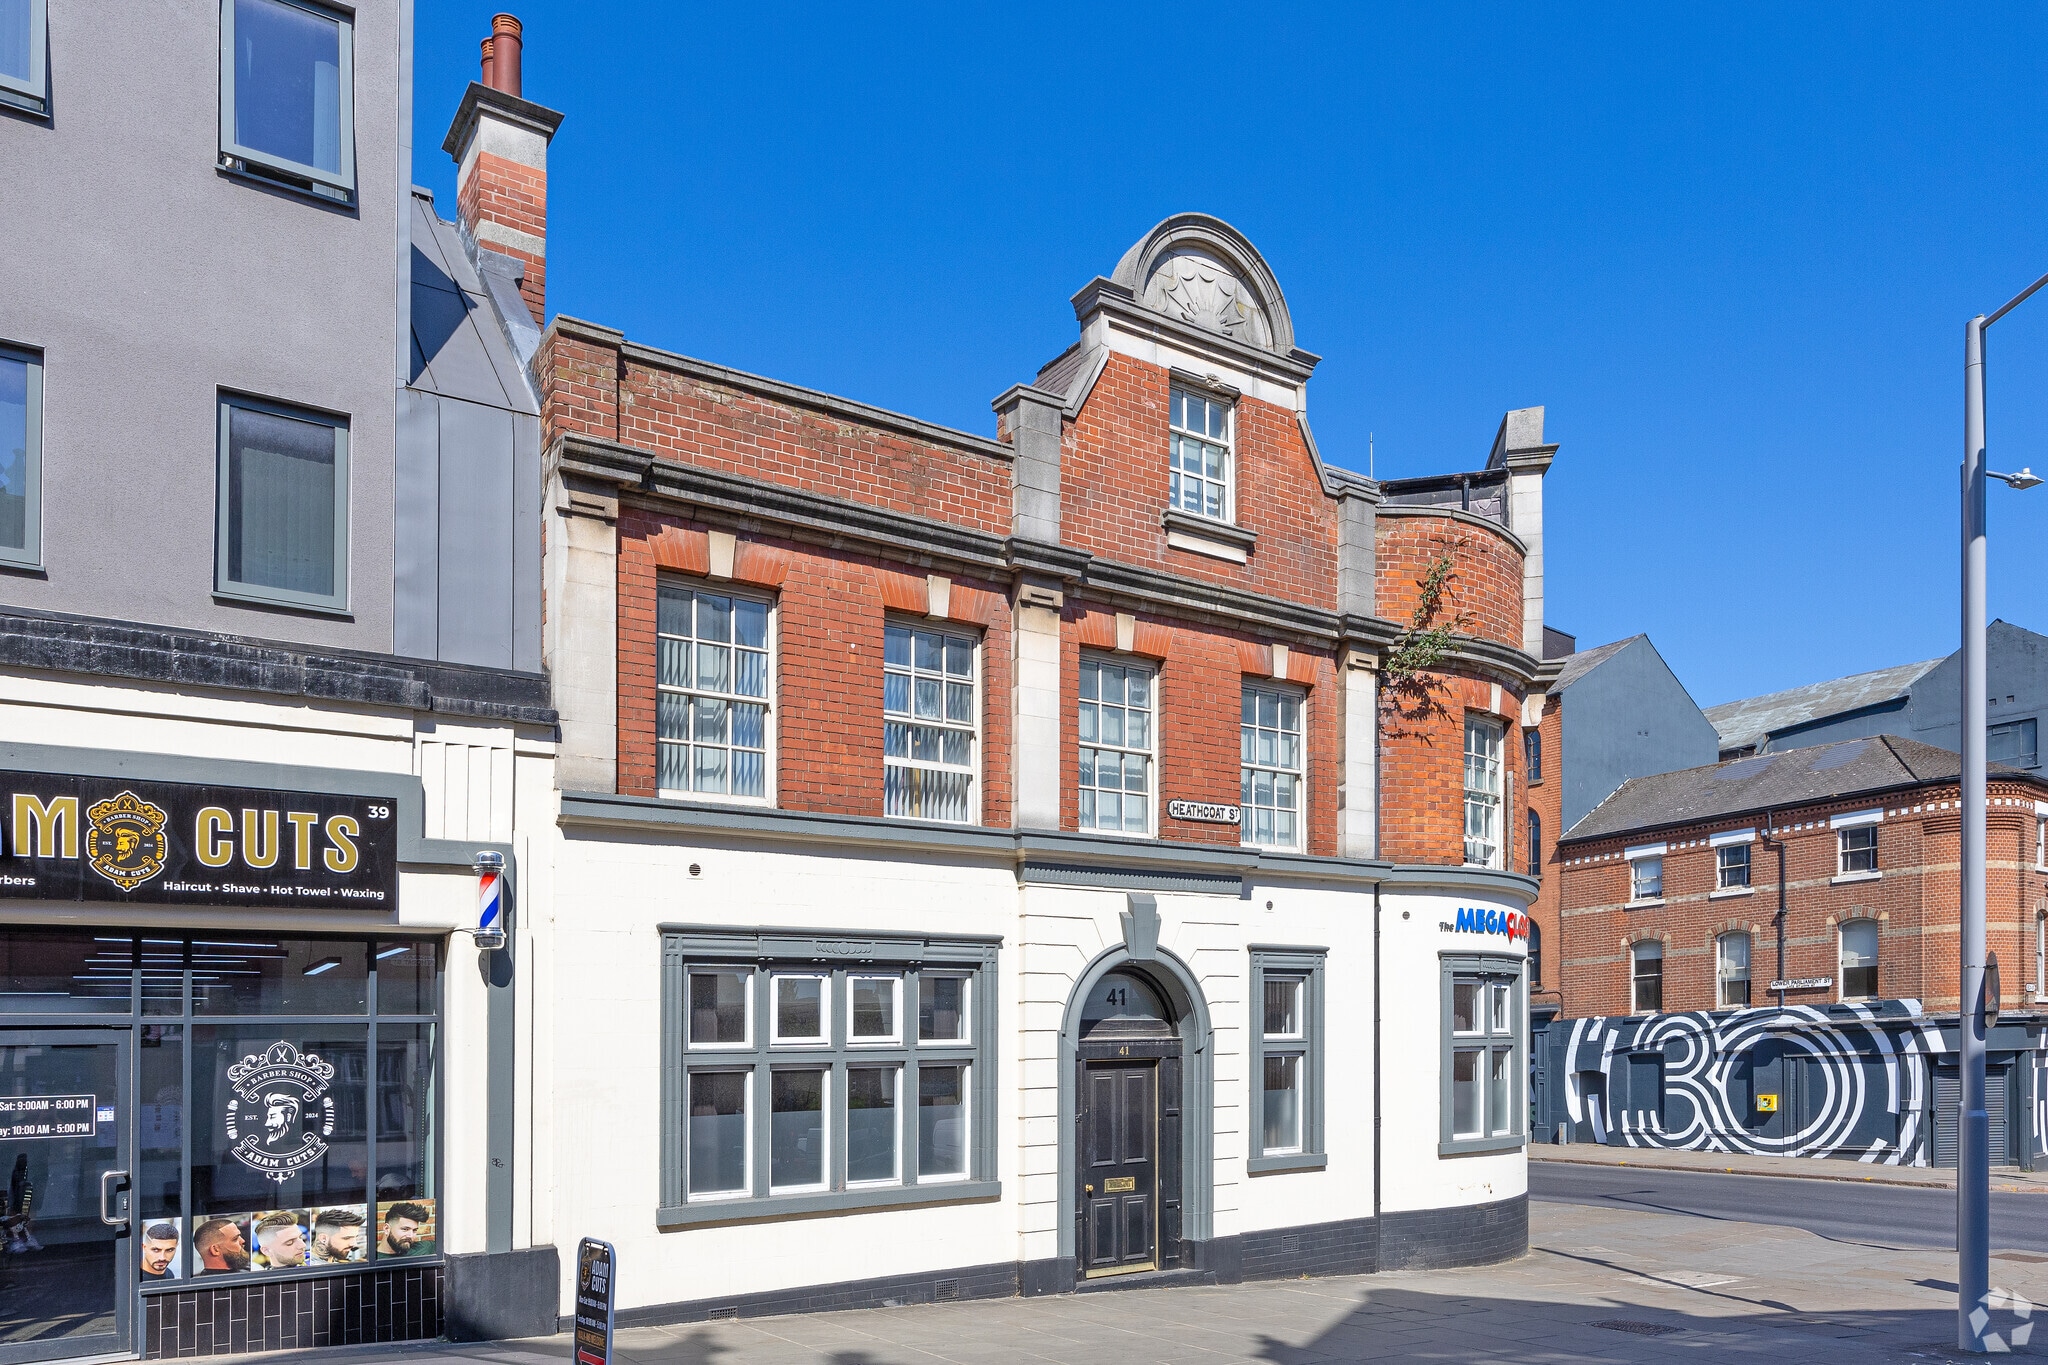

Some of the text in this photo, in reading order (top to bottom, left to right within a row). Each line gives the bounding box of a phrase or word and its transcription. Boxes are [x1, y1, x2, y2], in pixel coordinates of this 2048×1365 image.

[106, 814, 149, 824] BARBER SHOP
[368, 806, 390, 819] 39
[1172, 803, 1238, 820] HEATHCOAT ST
[195, 806, 360, 874] CUTS
[103, 865, 151, 876] ADAM CUTS
[163, 881, 385, 900] Haircut Shave Hot Towel Waxing
[1439, 922, 1454, 932] The
[1106, 988, 1126, 1006] 41
[1119, 1046, 1129, 1056] 41
[251, 1070, 313, 1085] BARBER SHOP
[17, 1101, 49, 1110] 9:00AM
[56, 1100, 75, 1109] 6:00
[76, 1099, 89, 1109] PM
[12, 1125, 35, 1135] 10:00
[36, 1125, 50, 1134] AM
[57, 1124, 75, 1133] 5:00
[76, 1123, 90, 1132] PM
[246, 1149, 314, 1167] ADAM CUTS
[591, 1260, 609, 1279] ADAM
[591, 1276, 607, 1294] CUTS
